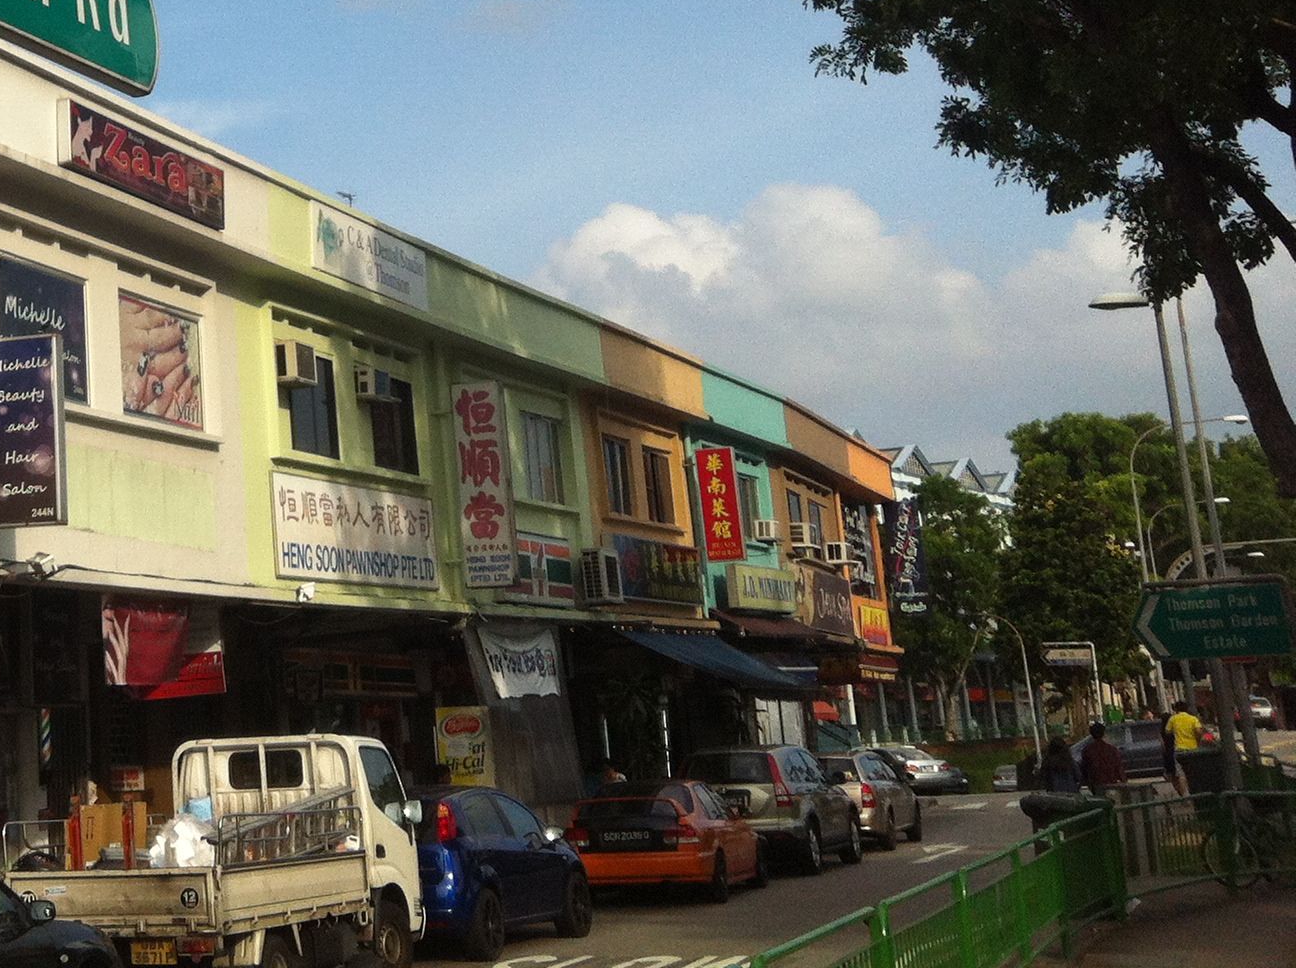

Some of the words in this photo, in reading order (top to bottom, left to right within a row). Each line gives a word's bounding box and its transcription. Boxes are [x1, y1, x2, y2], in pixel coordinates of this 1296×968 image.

[103, 122, 188, 197] Zara
[4, 294, 66, 332] Michelle
[5, 417, 40, 433] and
[5, 449, 40, 465] Hair
[2, 482, 48, 497] Salon
[281, 541, 313, 572] HENG
[315, 544, 346, 574] SOON
[345, 549, 400, 579] PAWNSHOP
[401, 555, 418, 580] PTE
[419, 557, 435, 581] LTD
[1165, 597, 1221, 612] Thomson
[1227, 593, 1258, 608] Park
[1167, 617, 1224, 631] Thomson
[1231, 614, 1279, 628] Garden
[1203, 635, 1247, 649] Estate
[182, 891, 196, 903] 12
